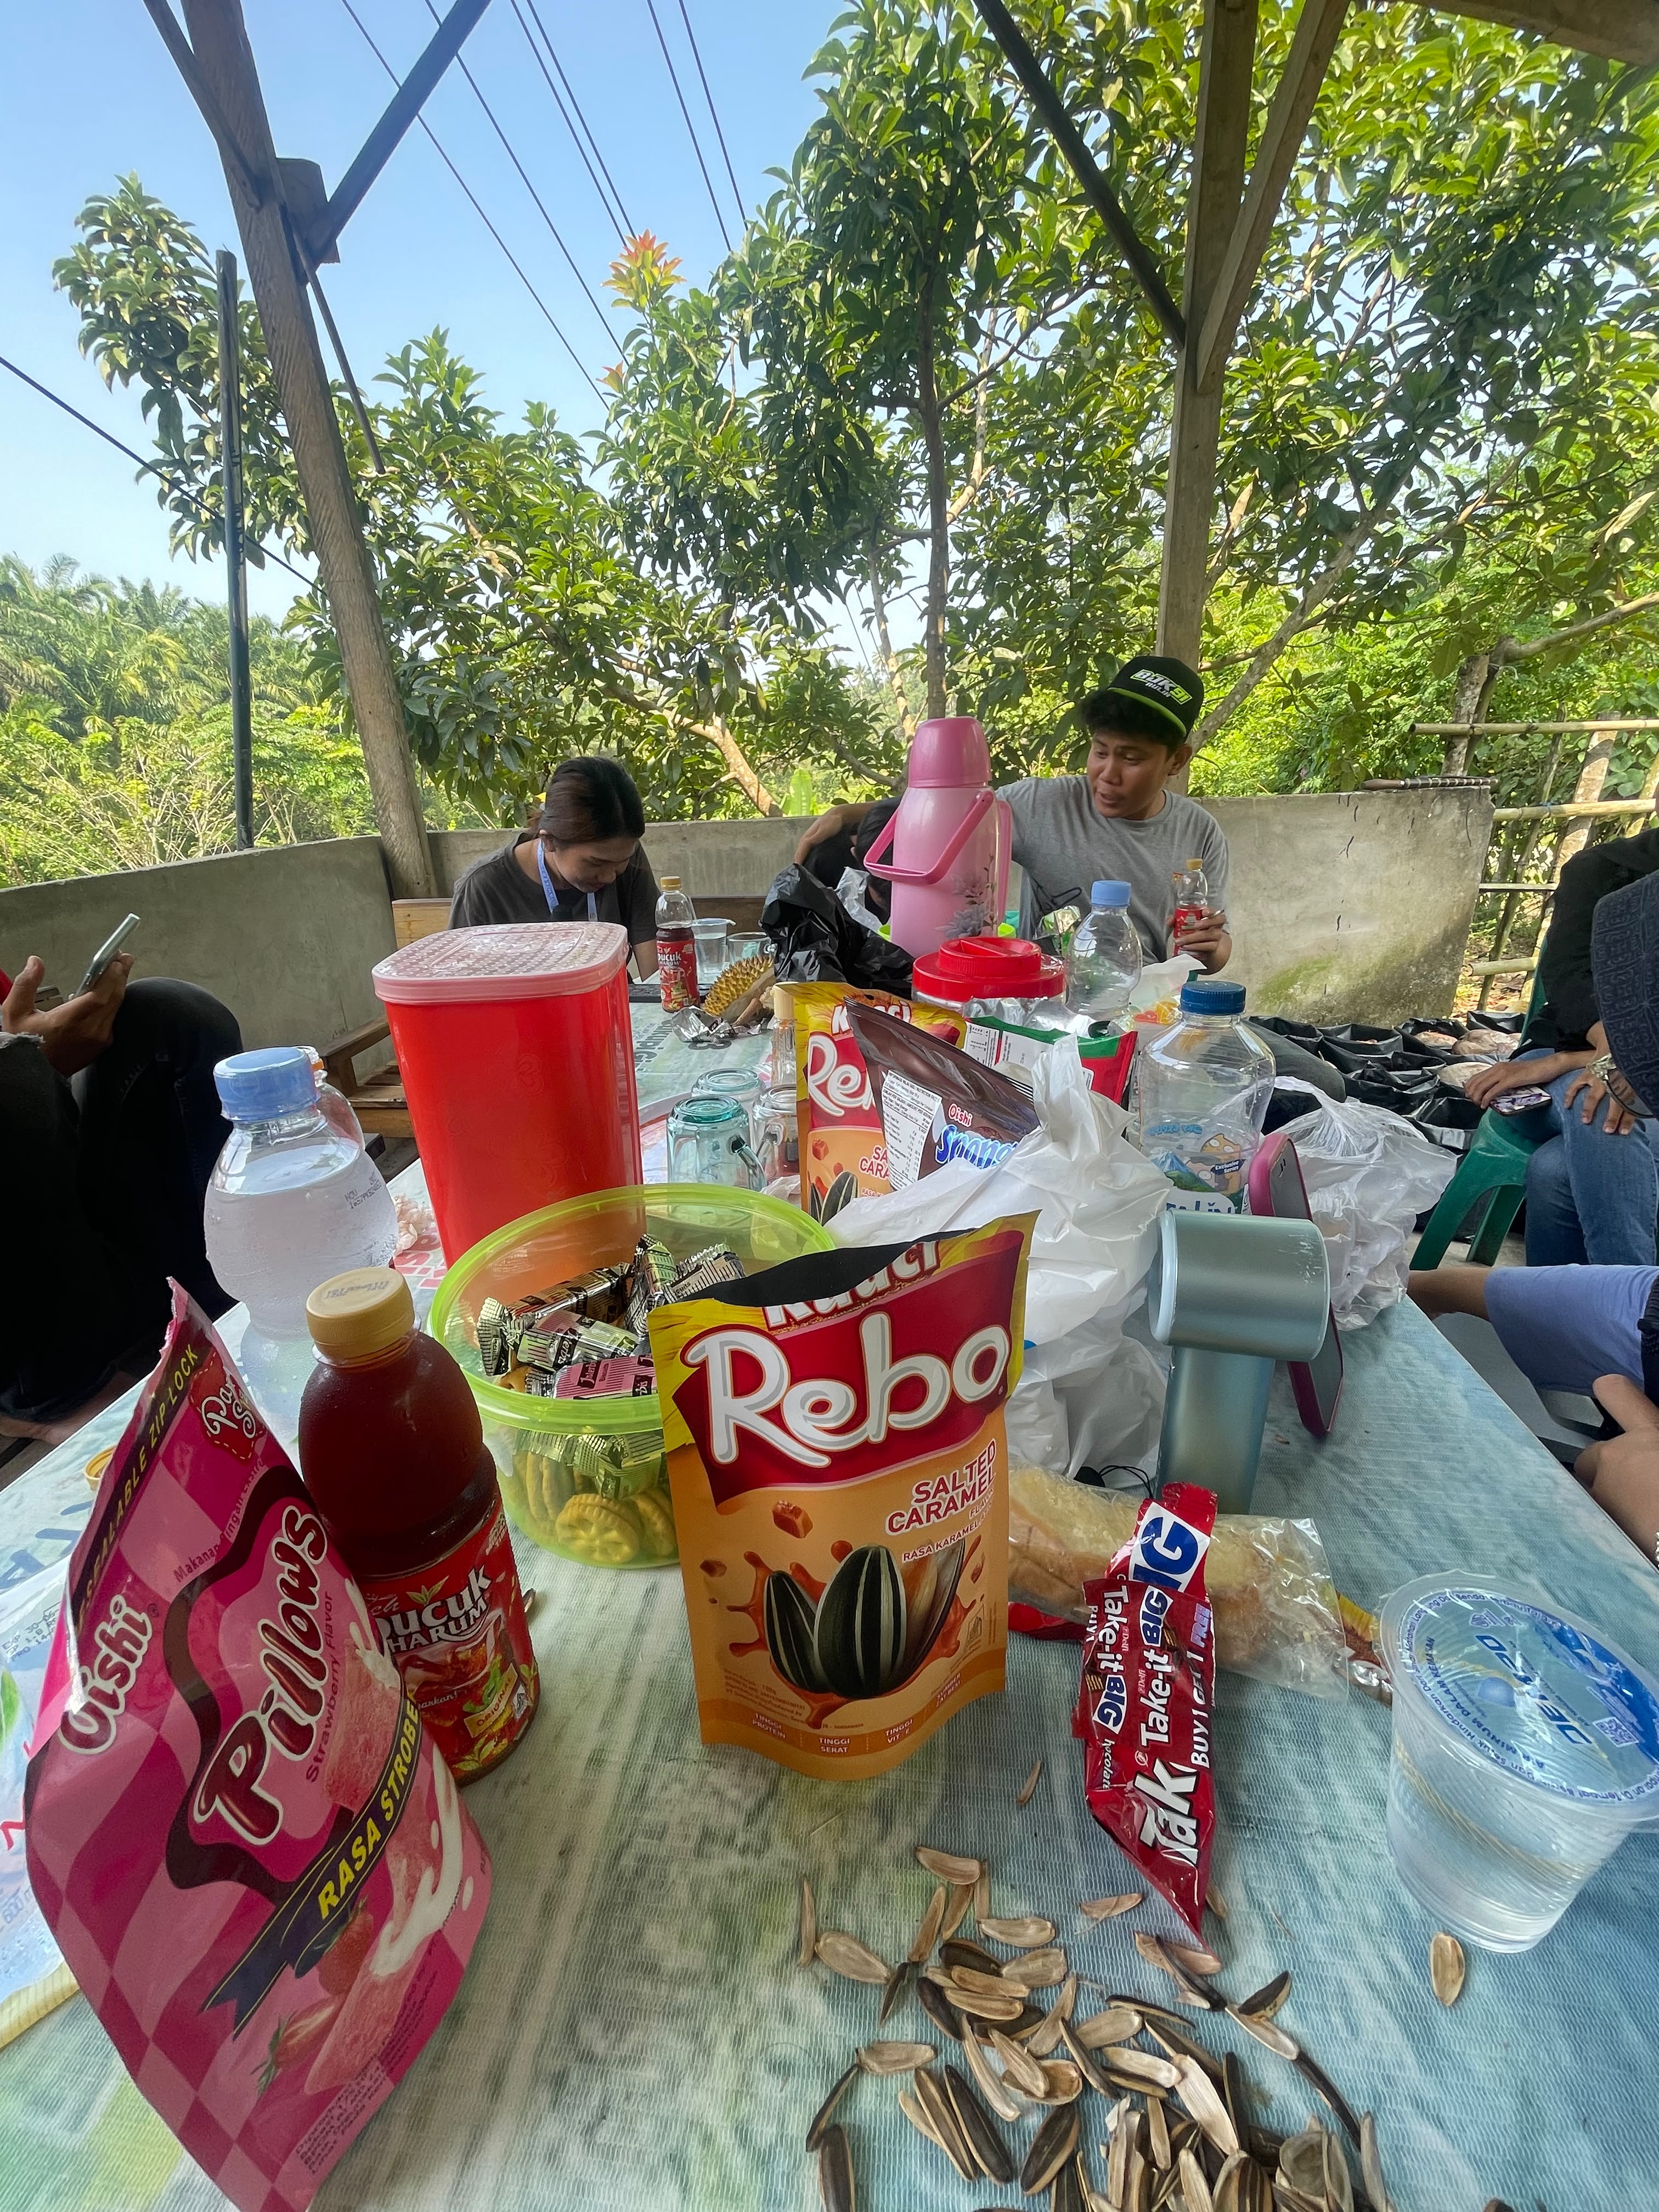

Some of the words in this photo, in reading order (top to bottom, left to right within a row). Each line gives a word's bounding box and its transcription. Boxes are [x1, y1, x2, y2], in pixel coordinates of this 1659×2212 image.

[949, 1104, 973, 1126] Oishi
[1215, 1161, 1239, 1171] Exclusive
[148, 1403, 167, 1449] ZIP
[170, 1344, 199, 1406] LOCK
[682, 1312, 1009, 1466] Rebo
[913, 1438, 997, 1504] SALTED
[886, 1466, 995, 1534] CARAMEL
[902, 1545, 933, 1562] RASA
[935, 1520, 979, 1551] KARAMEL
[323, 1594, 334, 1650] Flavor
[389, 1597, 488, 1654] HARUM
[1097, 1585, 1128, 1673] Take-it
[1142, 1590, 1168, 1645] BIG
[1190, 1603, 1212, 1648] FREE
[194, 1505, 328, 1846] Pillows
[1186, 1650, 1204, 1662] 1
[476, 1674, 513, 1728] ORIGINAL
[1097, 1677, 1125, 1728] BIG
[1139, 1649, 1172, 1747] Take-it
[1189, 1664, 1206, 1706] GET
[306, 1658, 341, 1783] Strawberry
[752, 1719, 786, 1739] PROTEIN
[754, 1712, 782, 1730] TINGGI
[884, 1718, 913, 1737] TINGGI
[1191, 1707, 1209, 1718] 1
[819, 1737, 850, 1745] TINGGI
[821, 1745, 848, 1753] SERAT
[1190, 1719, 1210, 1769] BUY
[317, 1823, 381, 1920] RASA
